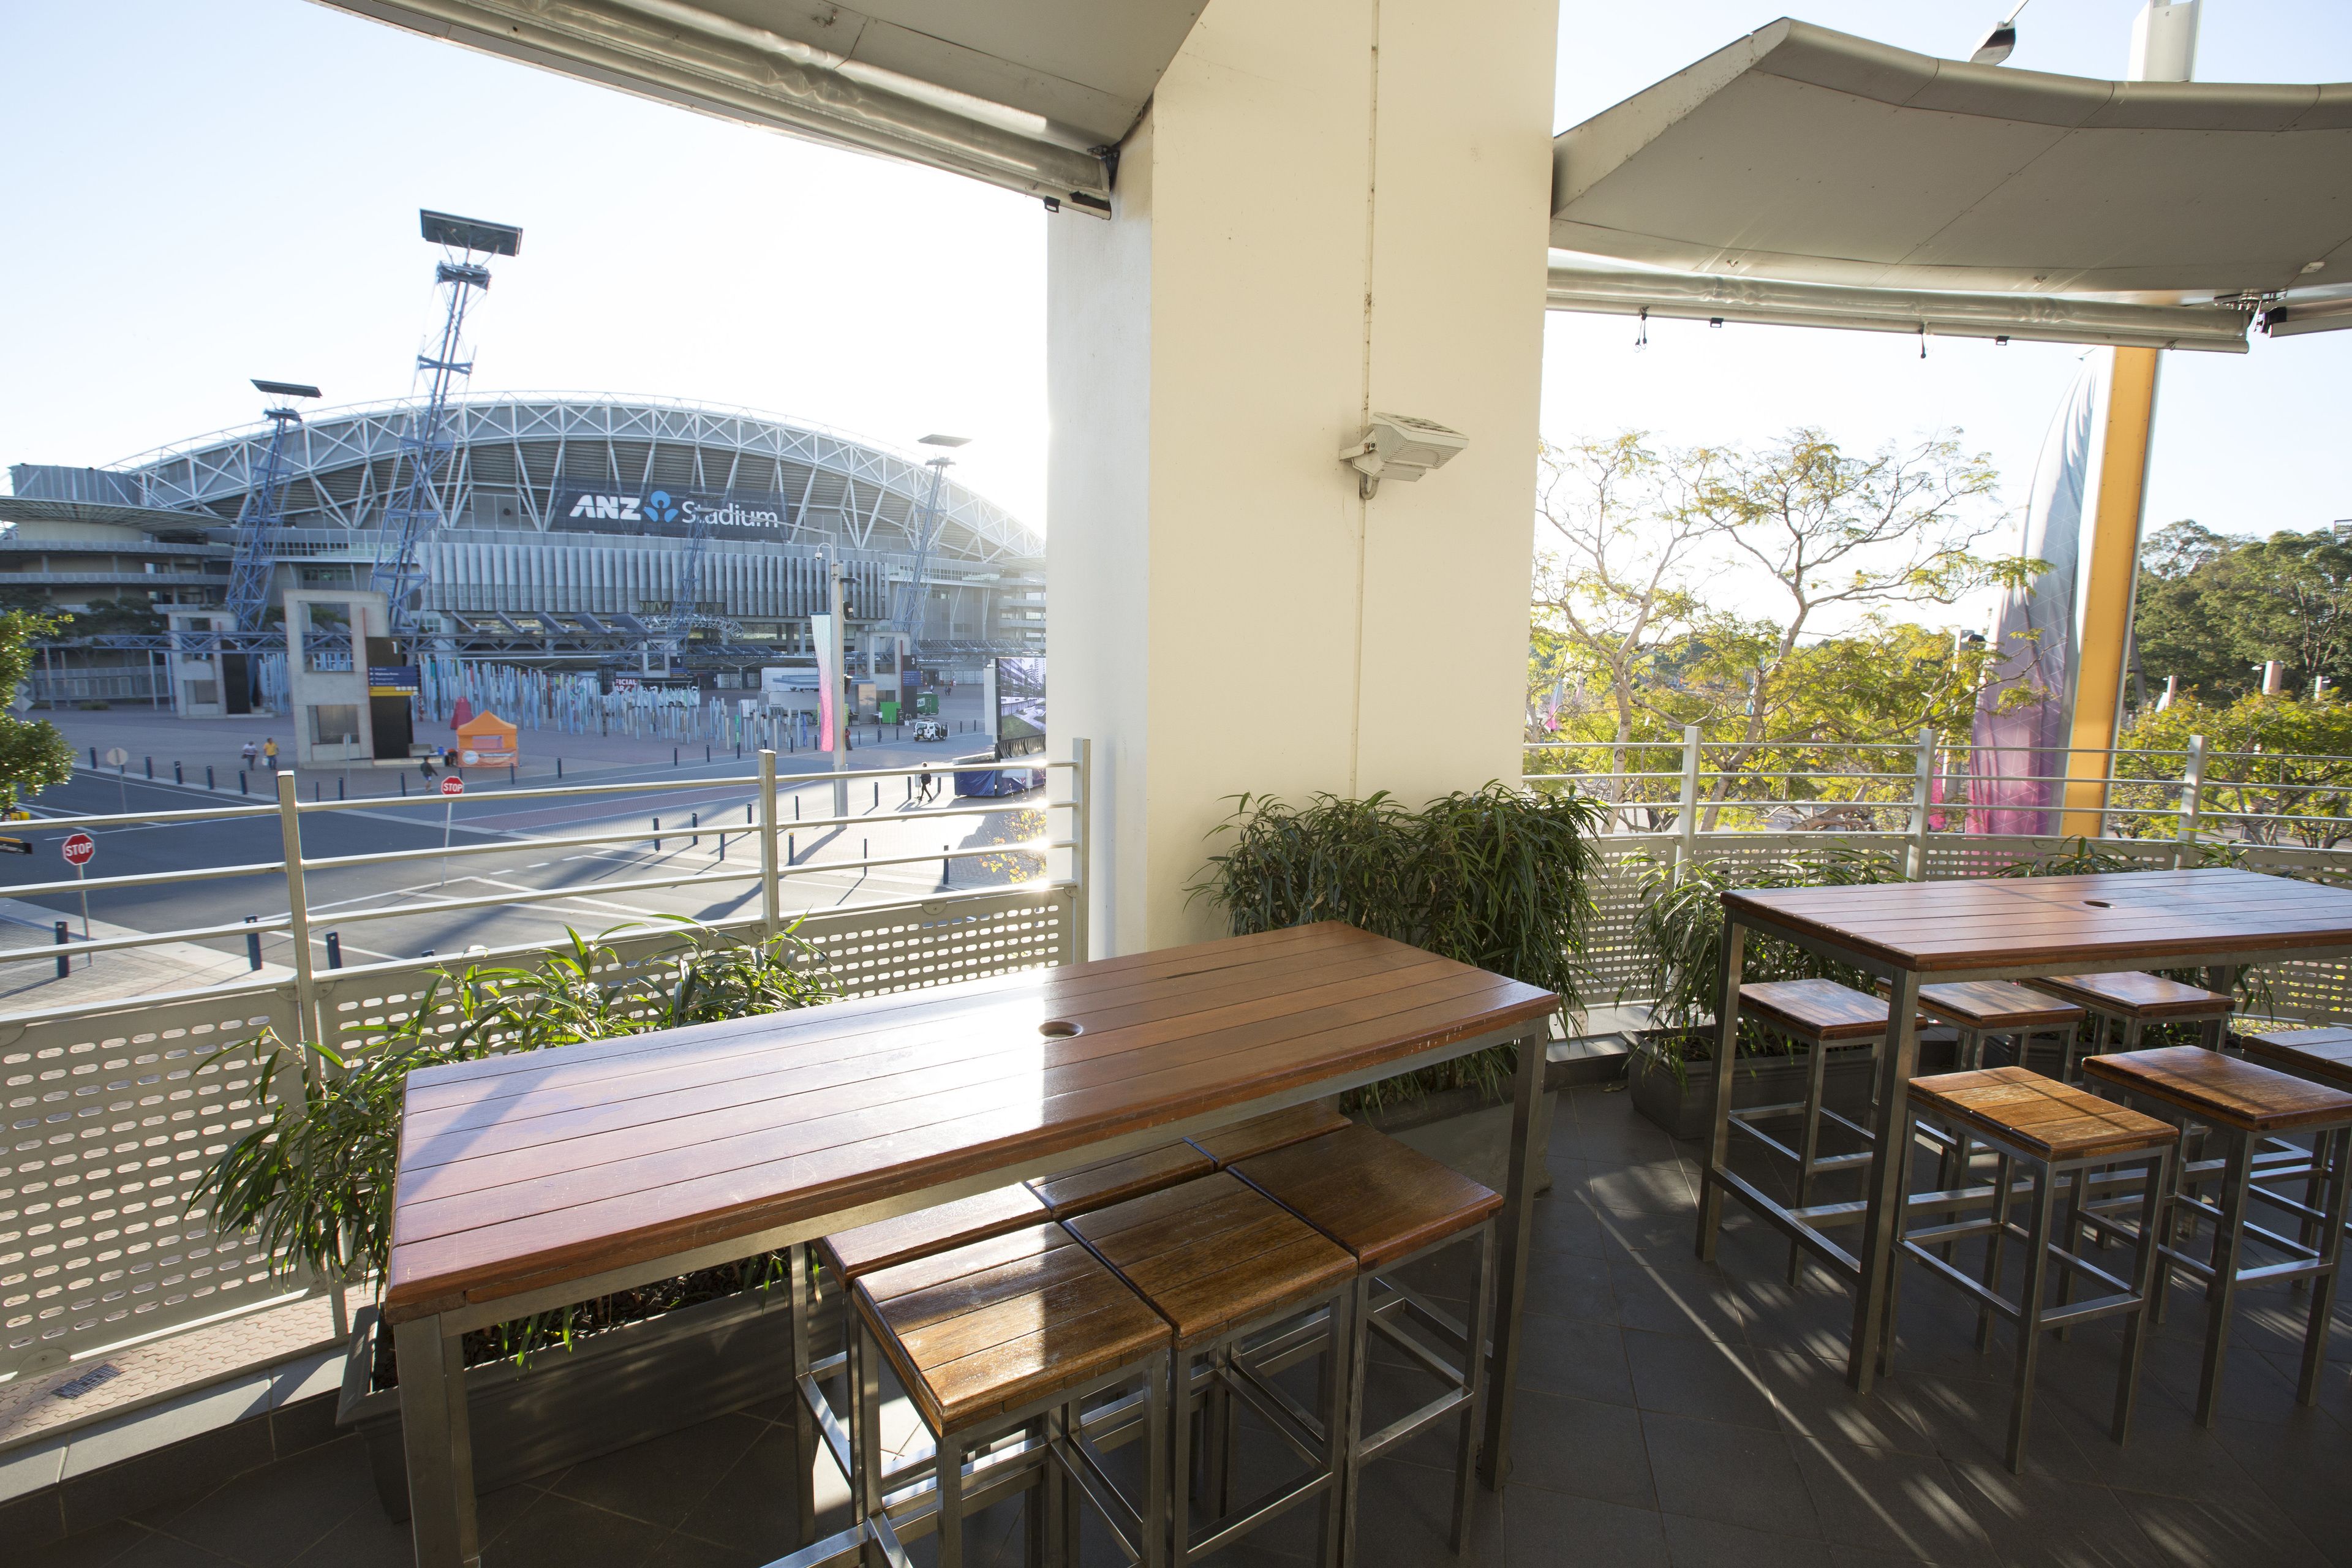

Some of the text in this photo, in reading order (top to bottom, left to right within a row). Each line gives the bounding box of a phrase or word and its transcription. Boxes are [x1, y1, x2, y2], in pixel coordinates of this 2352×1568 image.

[569, 494, 641, 521] ANZ
[392, 641, 398, 654] 1
[443, 783, 462, 792] STOP
[66, 842, 92, 856] STOP
